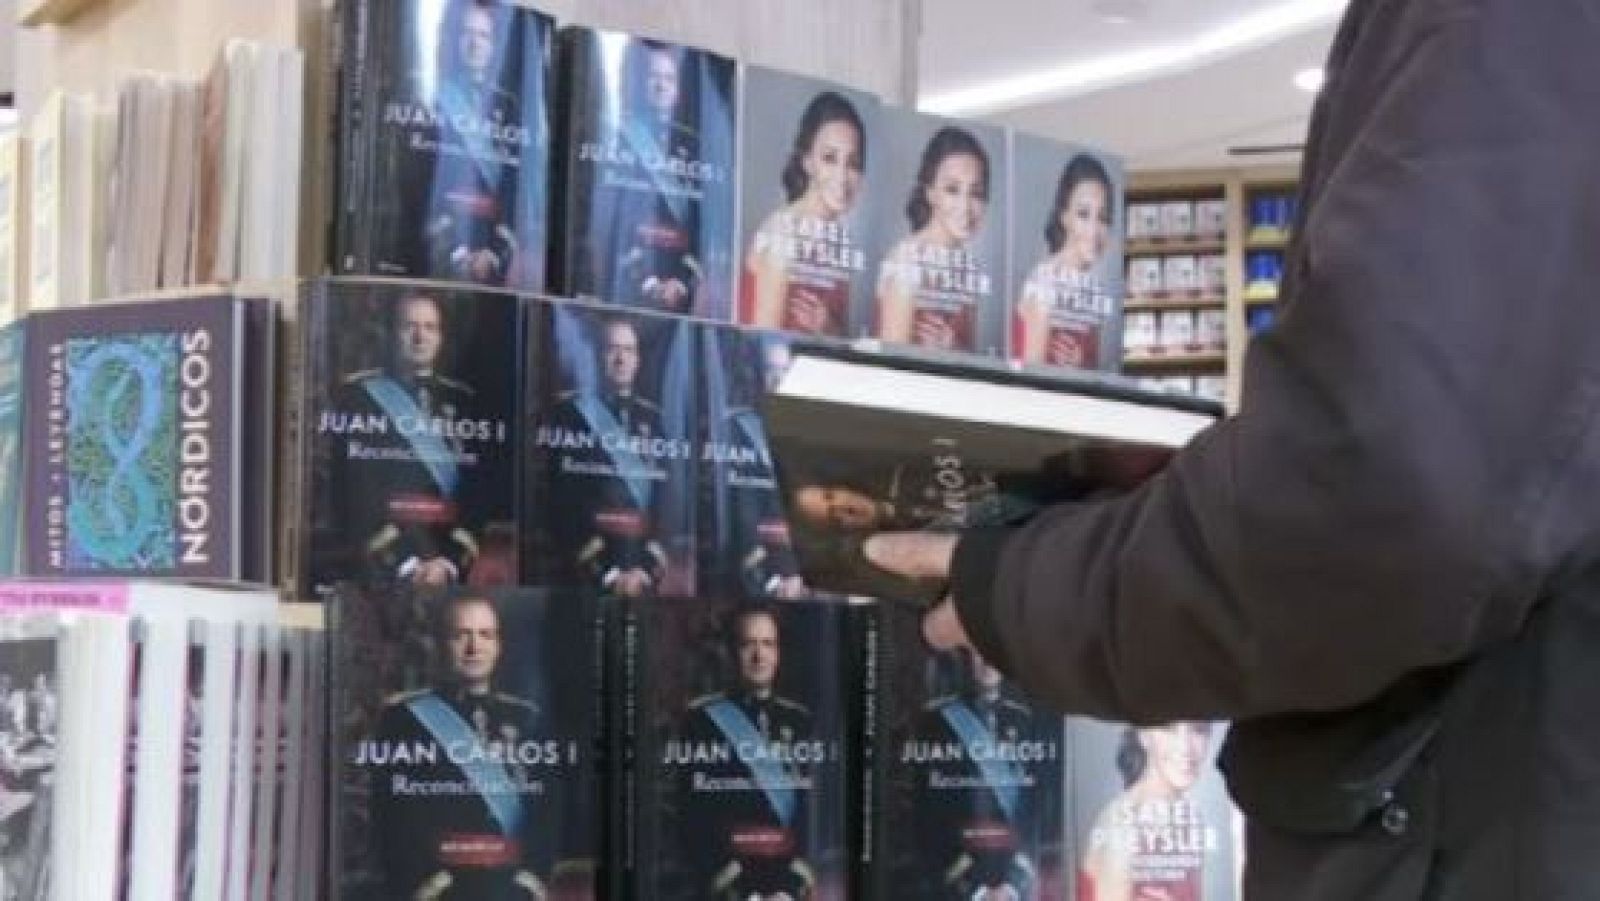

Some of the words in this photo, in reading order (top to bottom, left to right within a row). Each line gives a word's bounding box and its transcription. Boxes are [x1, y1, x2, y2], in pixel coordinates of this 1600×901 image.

[318, 411, 388, 434] JUAN
[394, 414, 491, 440] CARLOS
[495, 420, 506, 443] I
[536, 426, 596, 448] JUAN
[600, 431, 679, 460] CARLOS
[702, 441, 757, 463] JUAN
[353, 740, 438, 764] JUAN
[446, 740, 559, 765] CARLOS
[567, 740, 578, 764] I
[663, 739, 730, 765] JUAN
[737, 739, 825, 764] CARLOS
[901, 741, 963, 765] JUAN
[969, 739, 1045, 762] CARLOS
